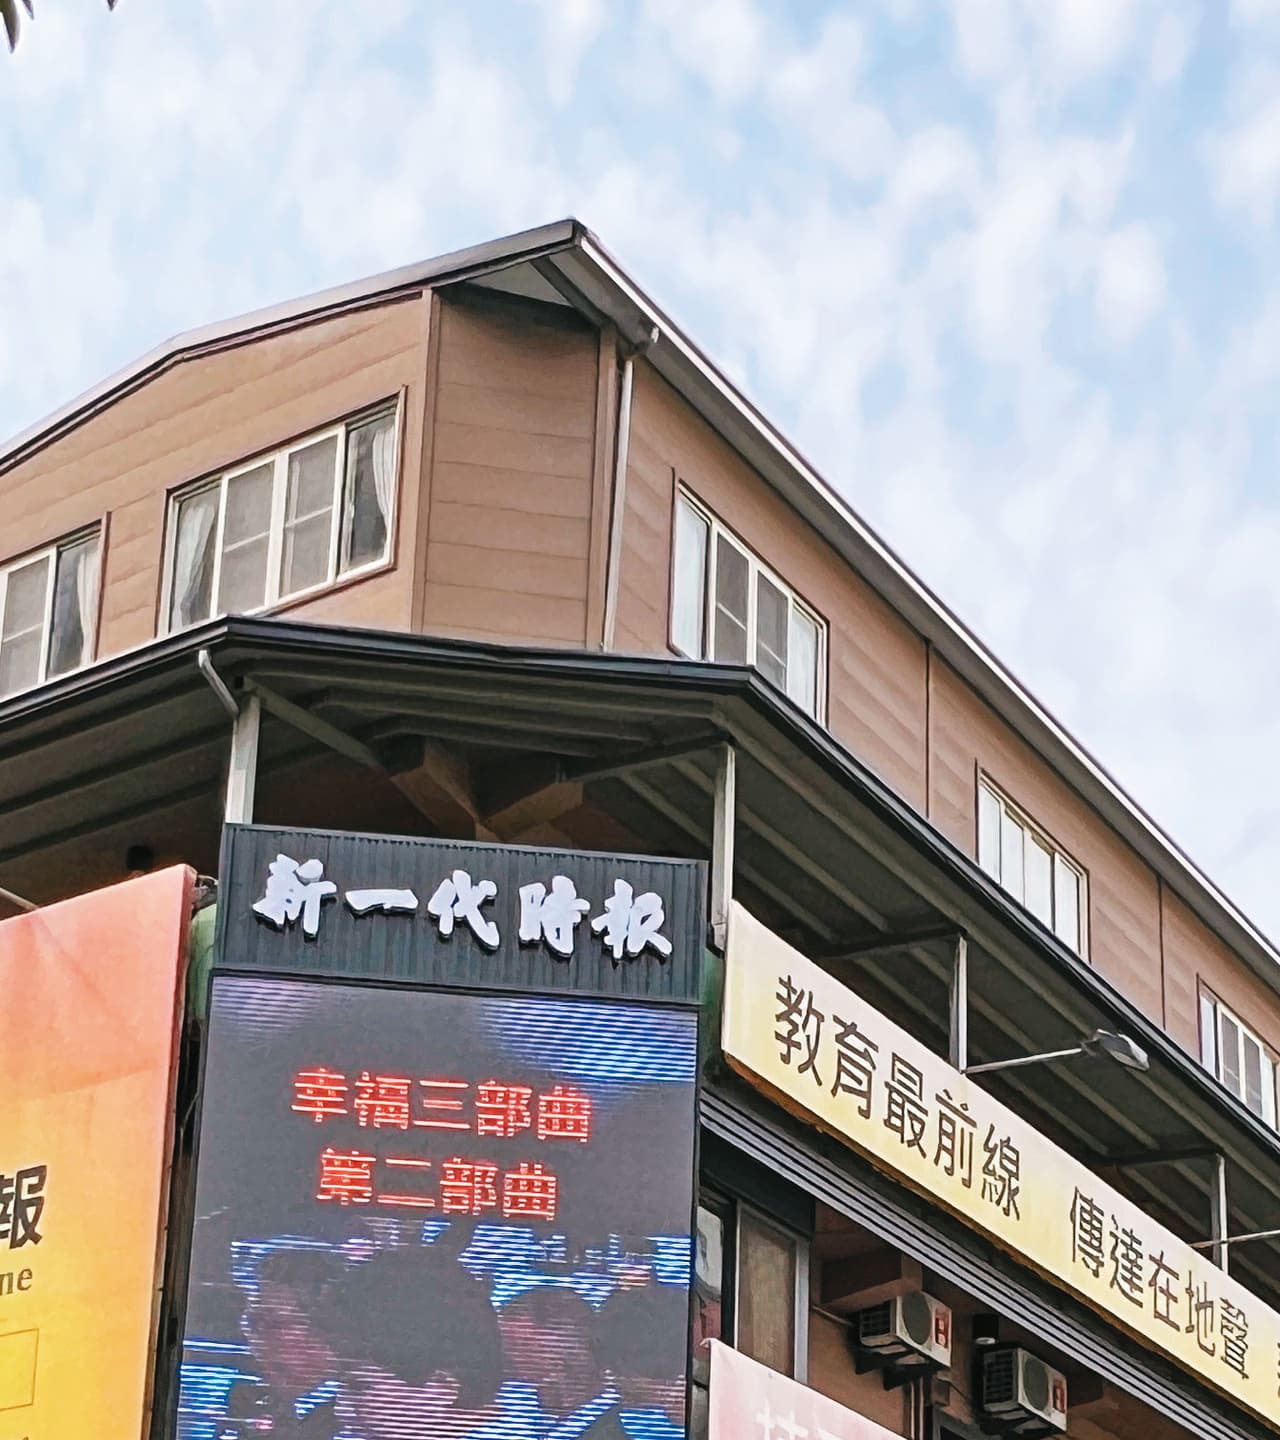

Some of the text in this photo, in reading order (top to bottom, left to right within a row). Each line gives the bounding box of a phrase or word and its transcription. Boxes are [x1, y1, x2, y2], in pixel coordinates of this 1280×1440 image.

[291, 1066, 592, 1142] 幸福三部曲
[774, 974, 1021, 1221] 教育最前線
[317, 1149, 558, 1221] 第二部曲
